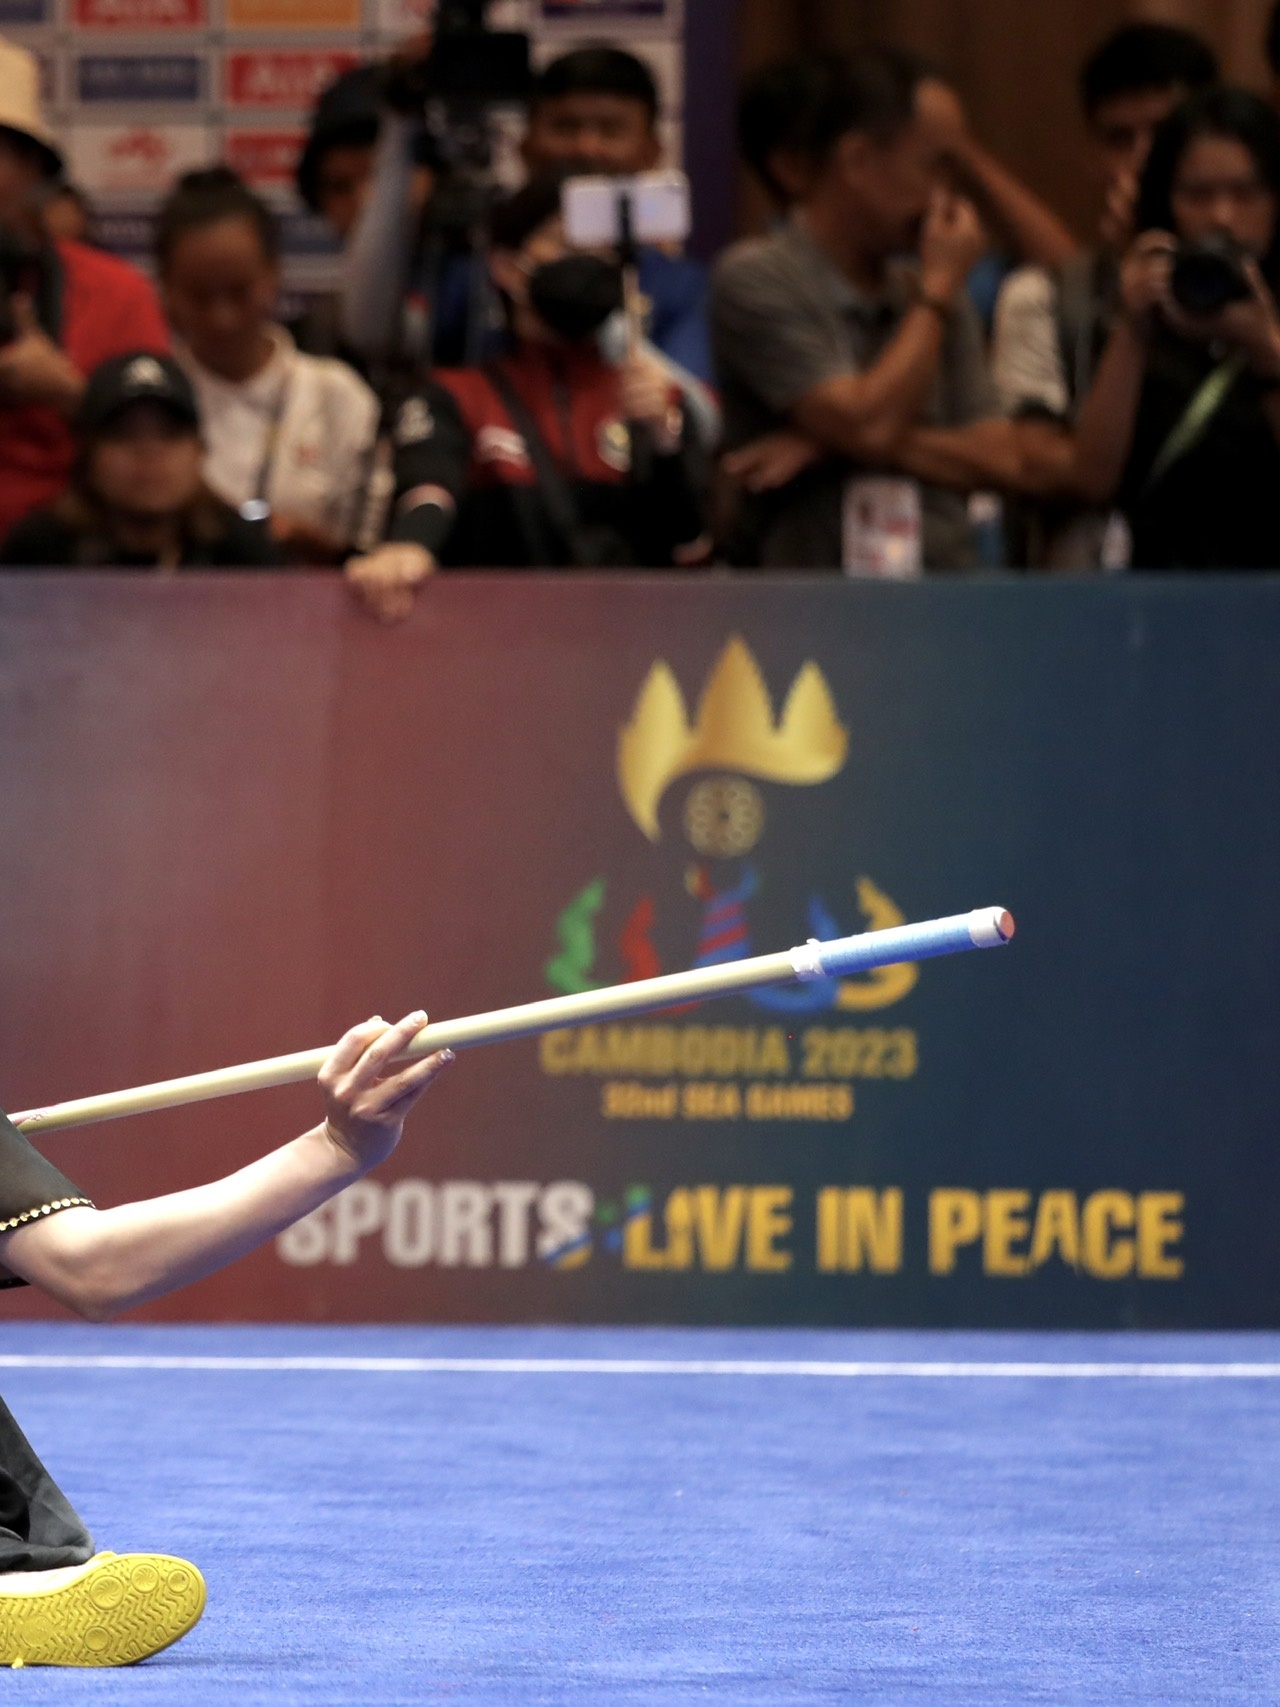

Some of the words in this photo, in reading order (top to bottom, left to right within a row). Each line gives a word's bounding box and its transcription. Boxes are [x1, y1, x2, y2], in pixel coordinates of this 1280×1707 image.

[540, 1026, 788, 1075] CAMBODIA
[802, 1029, 916, 1078] 2023
[682, 1084, 741, 1119] SEA
[746, 1085, 854, 1120] GAMES
[623, 1184, 792, 1273] LIVE
[817, 1187, 903, 1274] IN
[929, 1187, 1184, 1279] PEACE
